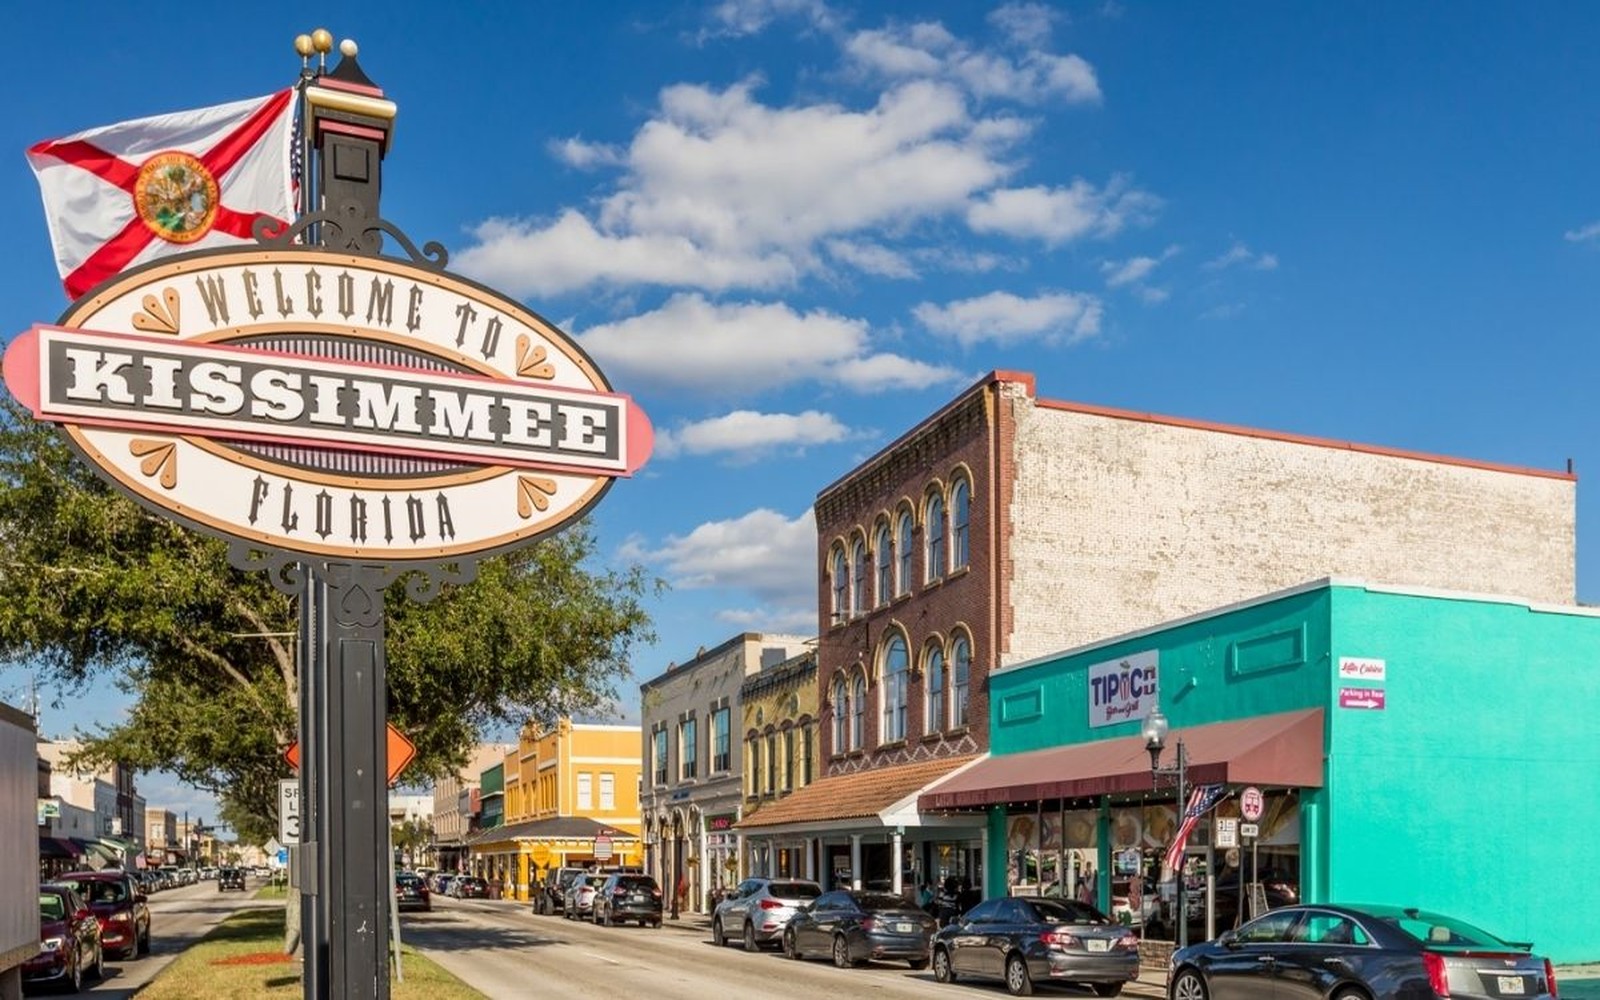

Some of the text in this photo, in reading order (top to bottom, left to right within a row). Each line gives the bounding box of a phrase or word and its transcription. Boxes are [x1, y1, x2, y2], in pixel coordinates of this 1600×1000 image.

[196, 267, 503, 361] WELCOME TO
[66, 347, 608, 455] KISSIMMEE
[248, 474, 457, 543] FLORIDA
[1340, 688, 1363, 699] Parking
